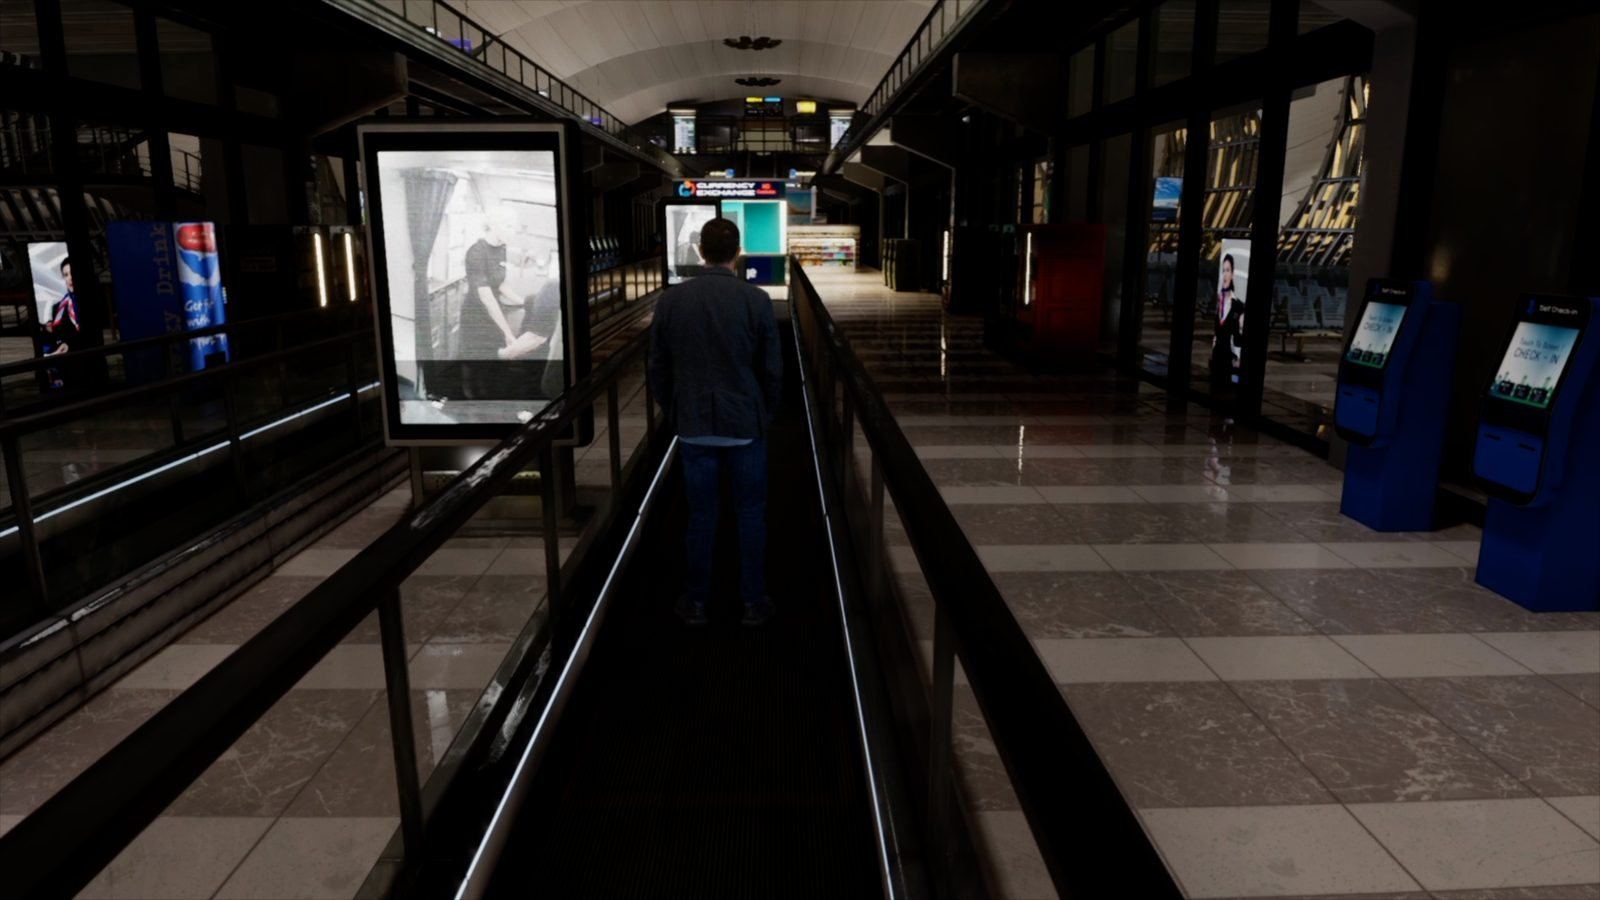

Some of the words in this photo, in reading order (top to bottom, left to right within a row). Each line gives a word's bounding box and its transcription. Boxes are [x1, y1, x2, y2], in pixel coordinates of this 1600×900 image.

[696, 189, 756, 197] EXCHANGE
[150, 222, 175, 298] Drink
[1539, 304, 1552, 313] Self
[1513, 346, 1542, 361] CHECK
[1549, 353, 1561, 364] IN
